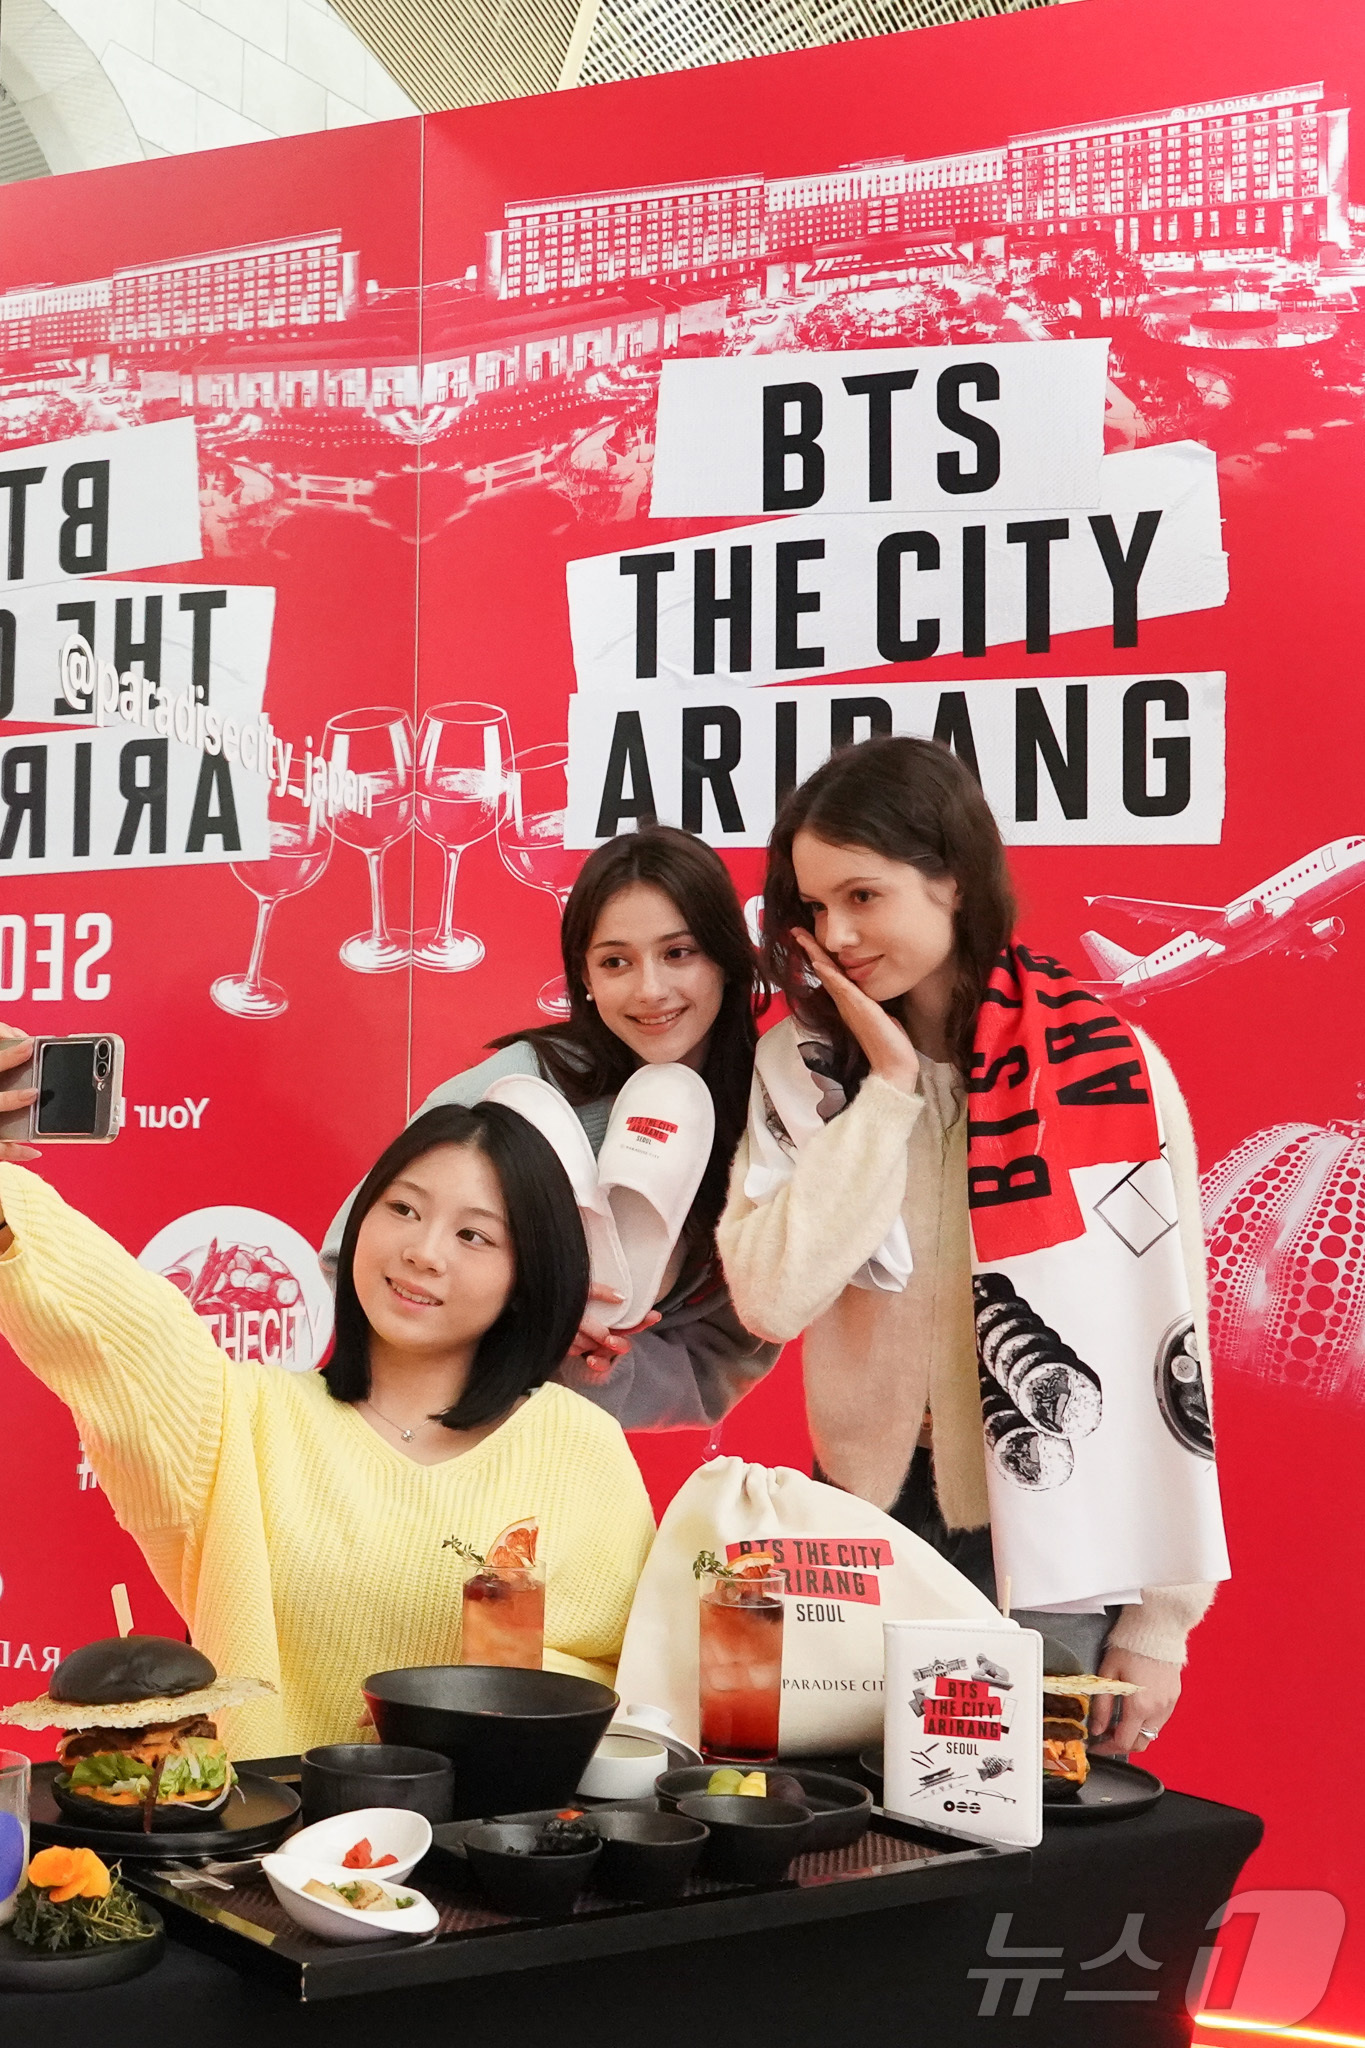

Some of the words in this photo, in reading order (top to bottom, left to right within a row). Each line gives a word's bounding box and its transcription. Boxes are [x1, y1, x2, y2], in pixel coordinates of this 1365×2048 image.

[762, 362, 1000, 512] BTS
[619, 539, 825, 679] THE
[876, 510, 1163, 662] CITY
[60, 633, 373, 818] @paradisecity_japan
[793, 1541, 833, 1566] THE
[837, 1545, 881, 1570] CITY
[796, 1604, 845, 1623] SEOUL
[783, 1678, 857, 1692] PARADISE
[948, 1682, 978, 1699] BTS
[931, 1700, 955, 1716] THE
[962, 1701, 995, 1719] CITY
[927, 1718, 999, 1739] ARIRANG
[946, 1742, 979, 1756] SEOUL
